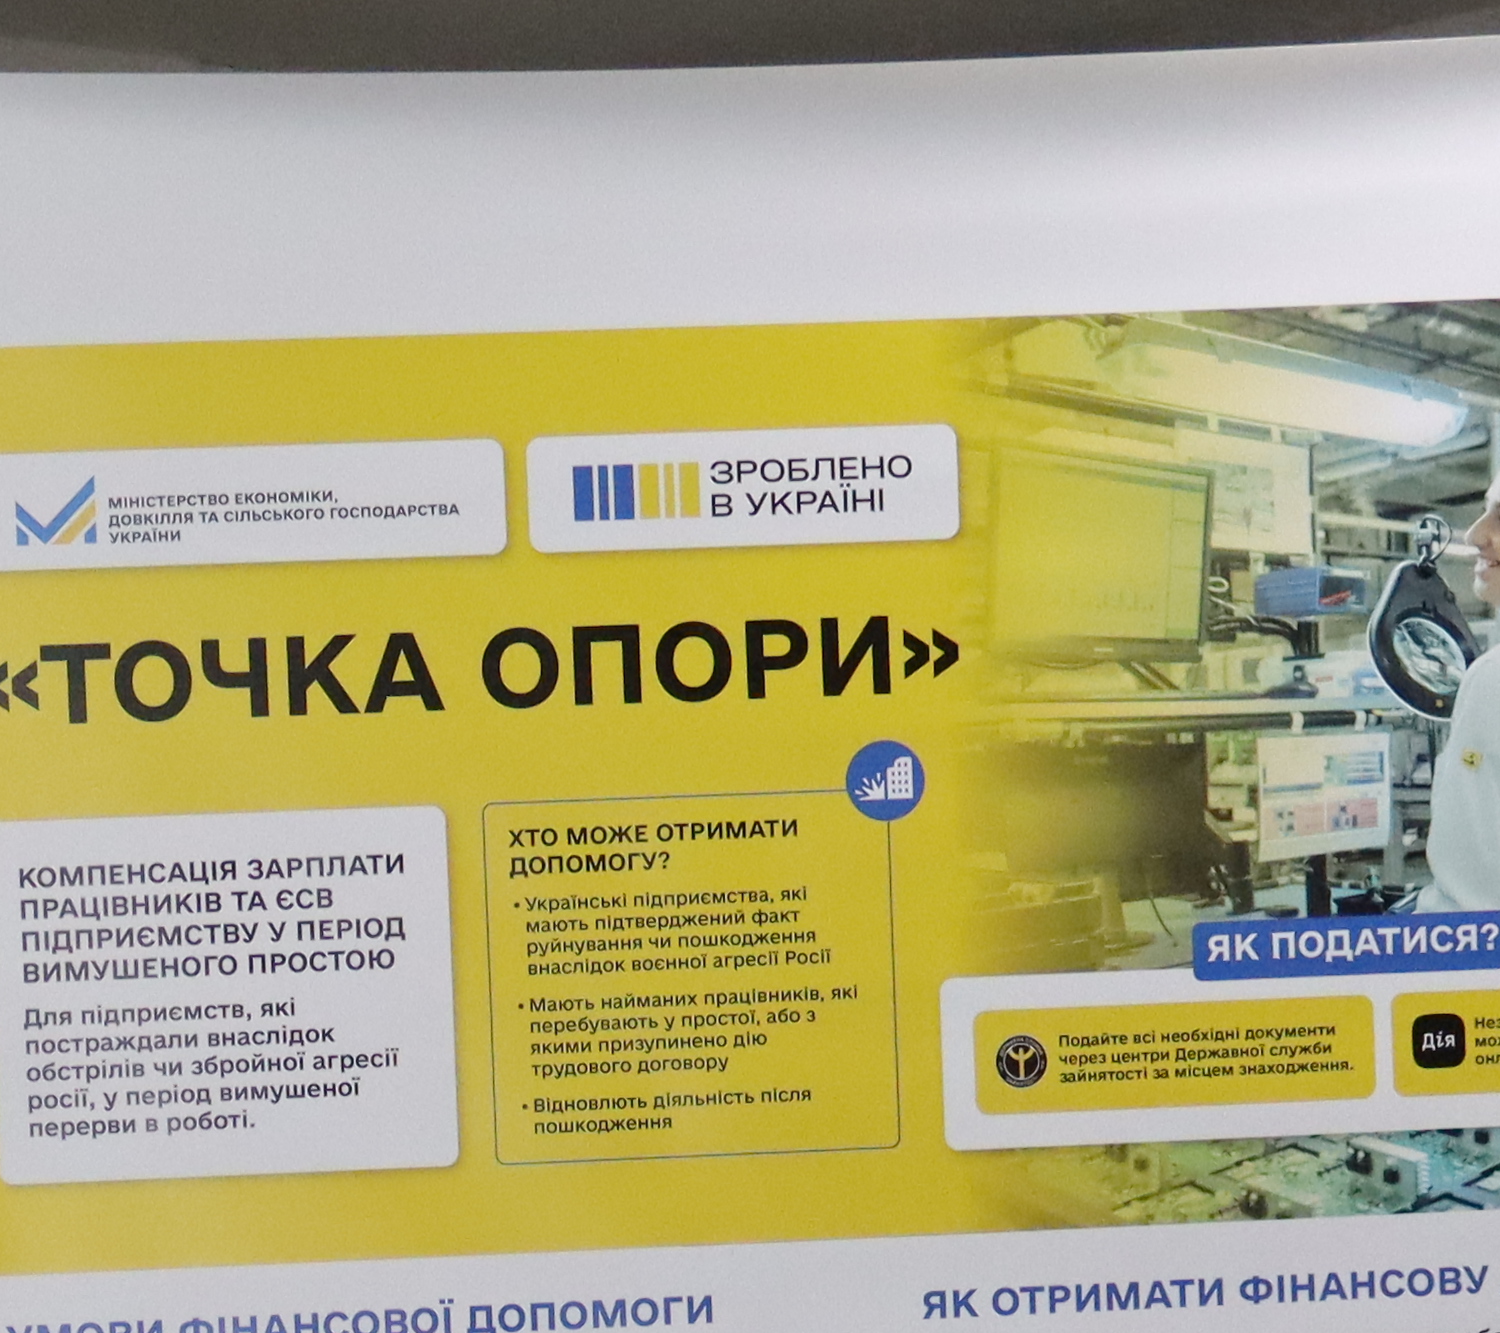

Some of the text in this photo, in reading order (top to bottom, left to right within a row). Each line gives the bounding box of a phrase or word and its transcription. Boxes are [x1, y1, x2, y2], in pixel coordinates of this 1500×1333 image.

[711, 455, 912, 487] ЗРОБЛЕНО
[108, 490, 338, 508] МІНІСТЕРСТВО ЕКОНОМІКИ,
[711, 483, 884, 517] В УКРАЇНІ
[109, 504, 459, 528] ДОВКІЛЛЯ ТА СІЛЬСЬКОГО ГОСПОДАРСТВА
[110, 528, 181, 544] УКРАЇНИ
[482, 616, 959, 709] ОПОРИ»
[510, 819, 797, 847] ХТО МОЖЕ ОТРИМАТИ
[19, 853, 404, 888] КОМПЕНСАЦІЯ ЗАРПЛАТИ
[509, 851, 670, 878] ДОПОМОГУ?
[20, 888, 333, 921] ПРАЦІВНИКІВ ТА ЄСВ
[22, 917, 406, 954] ПІДПРИЄМСТВУ У ПЕРІОД
[1208, 923, 1499, 962] ЯК ПОДАТИСЯ?
[23, 948, 395, 983] ВИМУШЕНОГО ПРОСТОЮ
[1422, 1031, 1455, 1051] Дія
[923, 1289, 978, 1319] ЯК
[992, 1278, 1223, 1316] ОТРИМАТИ
[1239, 1265, 1488, 1304] ФІНАНСОВУ
